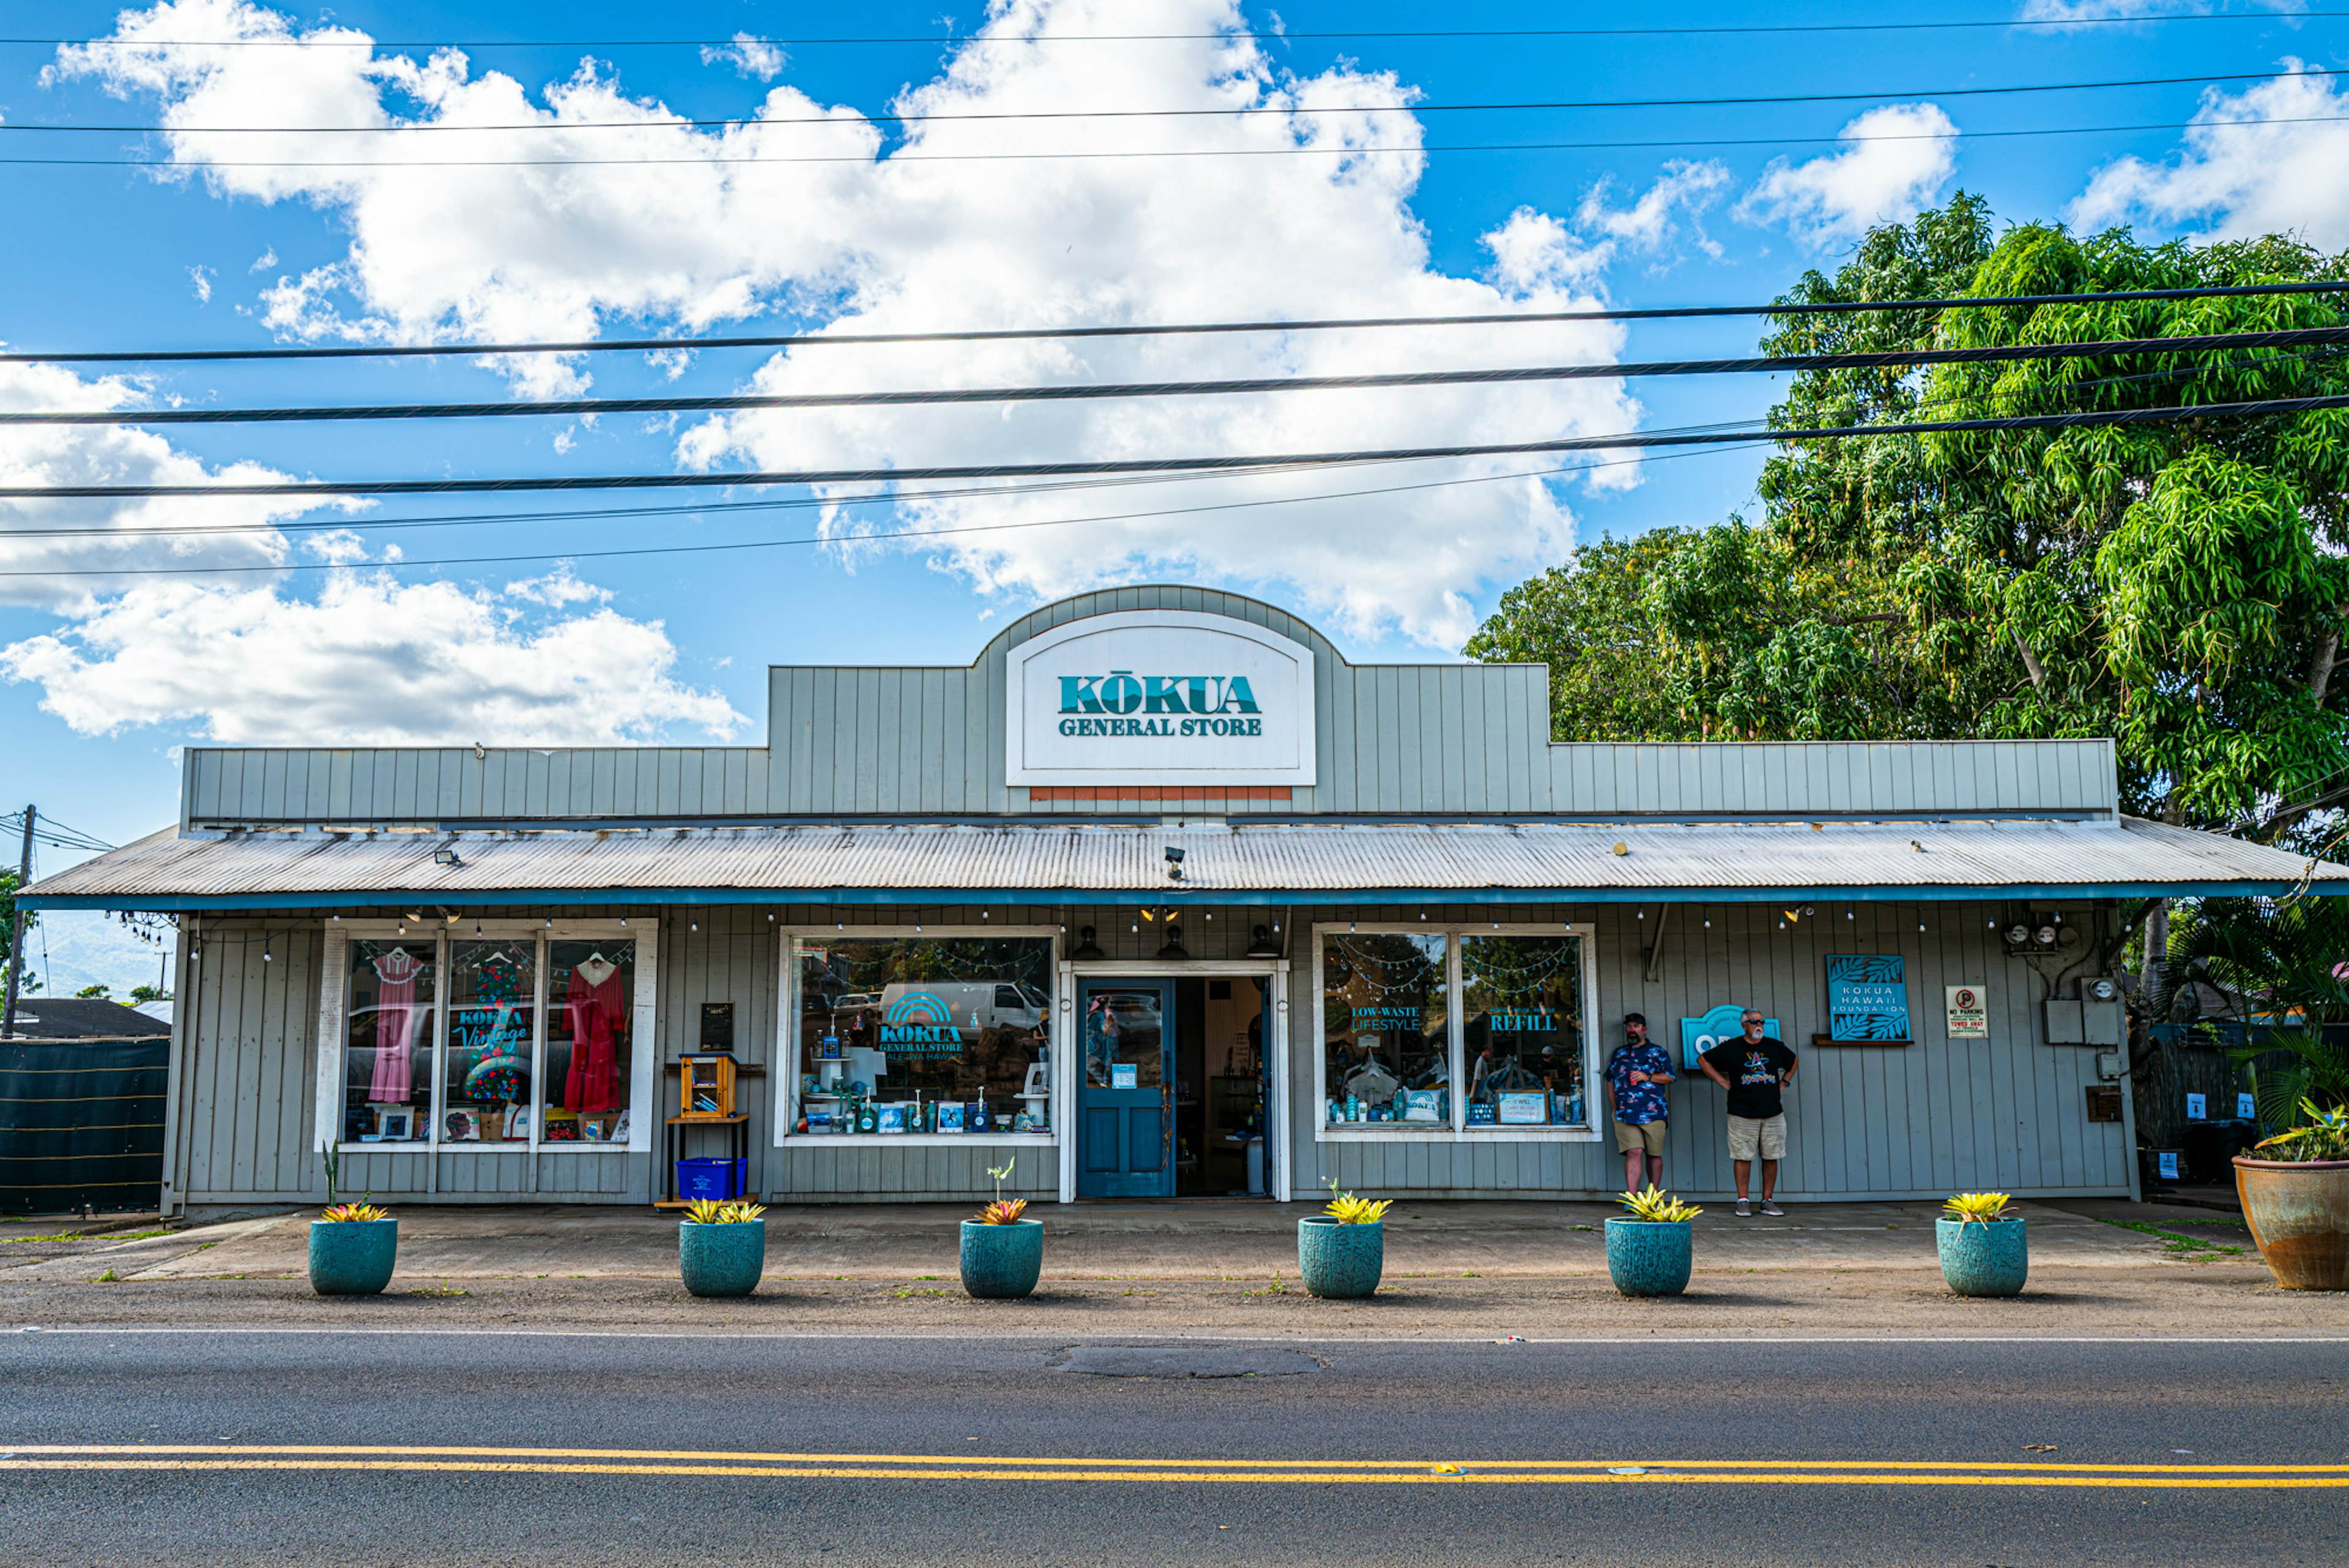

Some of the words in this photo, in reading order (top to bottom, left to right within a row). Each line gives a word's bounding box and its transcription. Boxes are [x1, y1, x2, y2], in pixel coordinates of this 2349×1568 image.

[1058, 671, 1262, 714] KŌKUA
[1058, 719, 1174, 737] GENERAL
[1180, 718, 1262, 737] STORE
[1842, 986, 1893, 995] KOKUA
[1352, 1007, 1420, 1017] LOW-WASTE
[1352, 1019, 1420, 1030] LIFESTYLE
[1490, 1014, 1557, 1031] REFILL
[451, 1026, 527, 1052] Vintage
[879, 1043, 927, 1052] GENERAL
[929, 1043, 964, 1052] STORE
